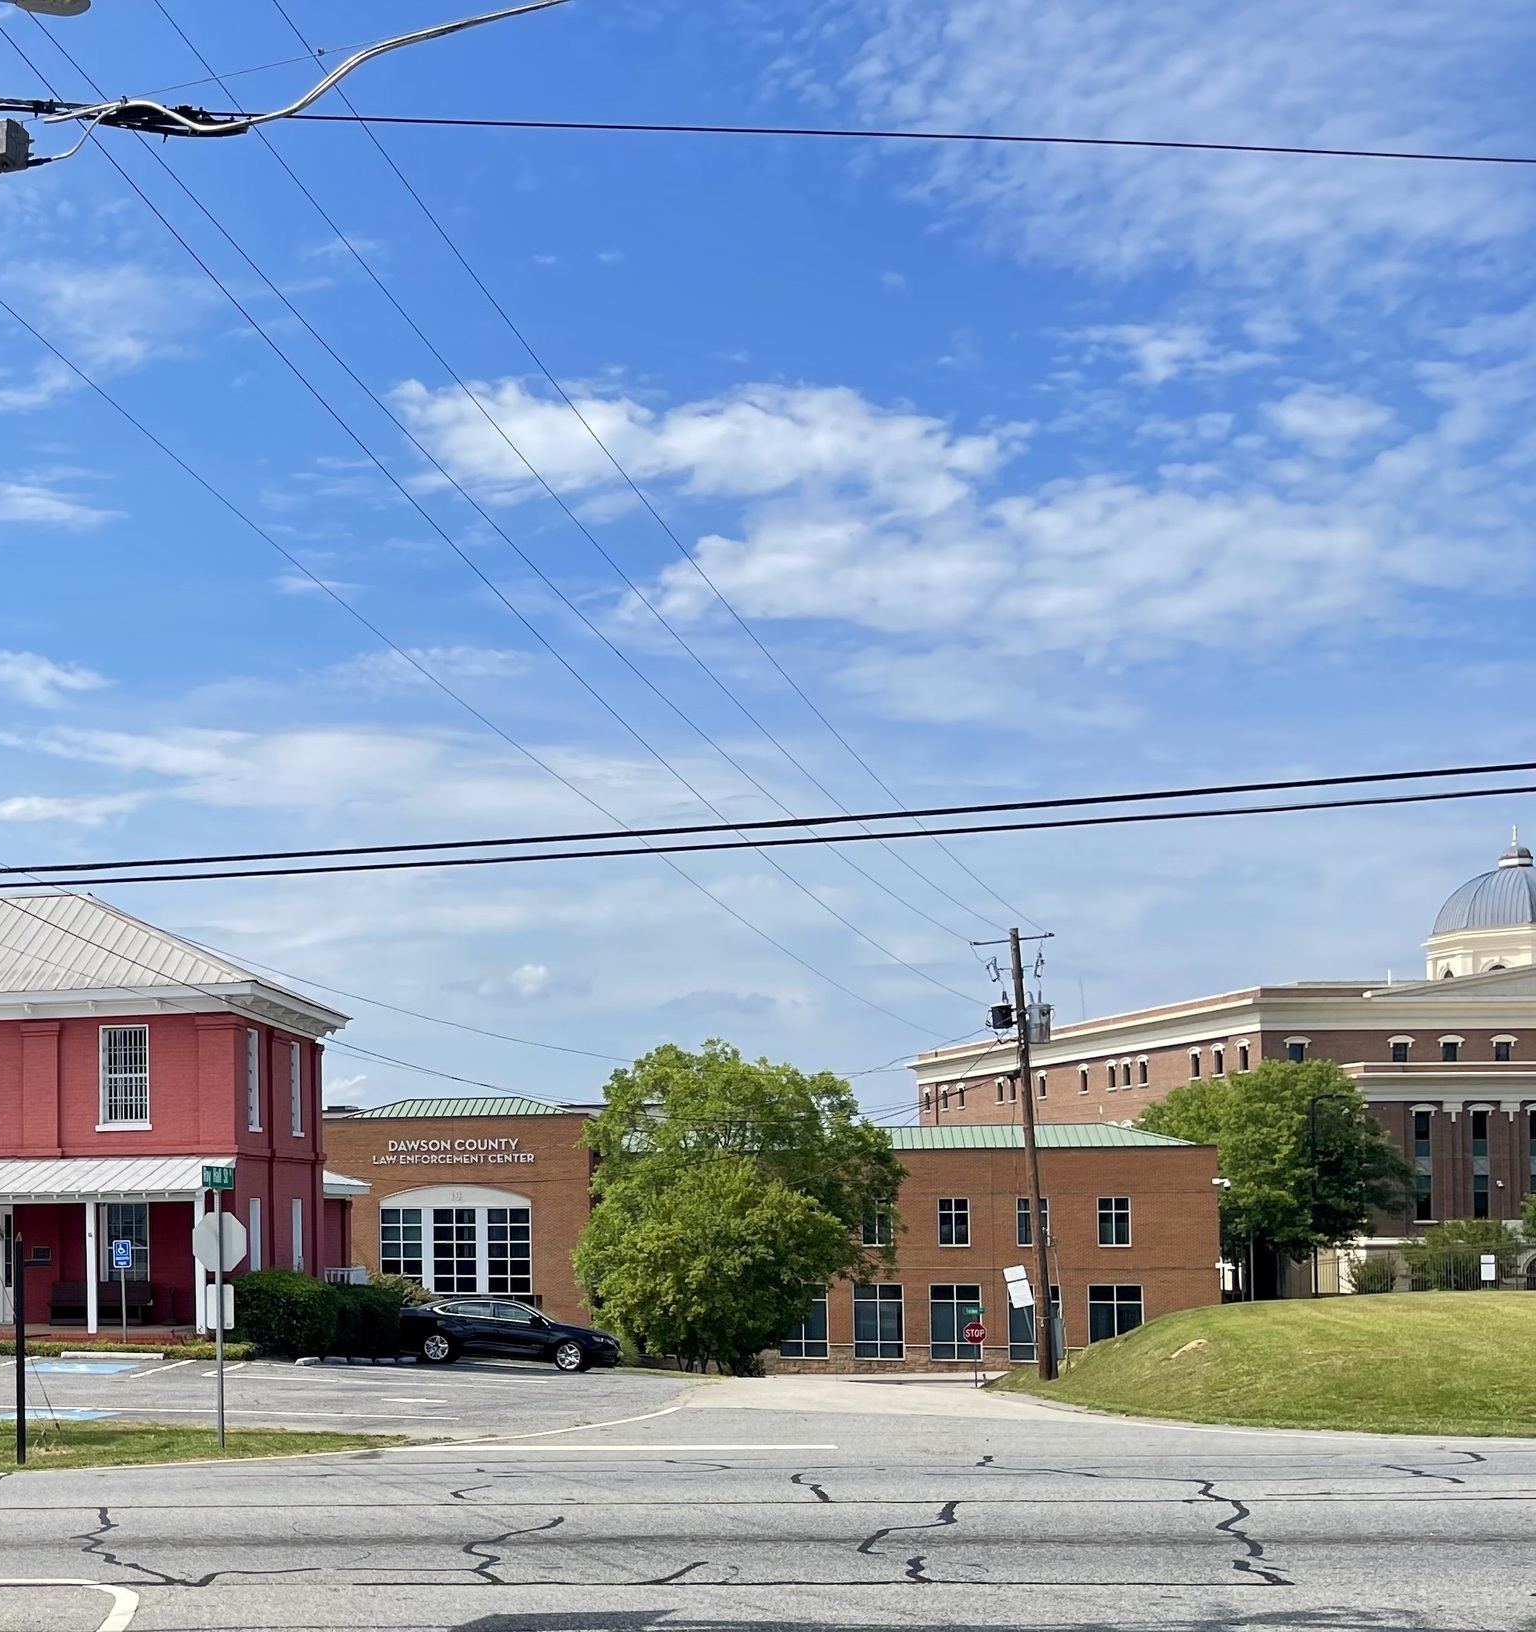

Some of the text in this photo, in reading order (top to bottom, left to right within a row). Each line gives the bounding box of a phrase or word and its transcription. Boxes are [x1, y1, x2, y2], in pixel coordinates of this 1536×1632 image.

[388, 1138, 519, 1152] DAWSON COUNTY
[372, 1153, 535, 1165] LAW ENFORCEMENT CENTER
[451, 1190, 462, 1201] 19
[965, 1329, 985, 1338] STOP
